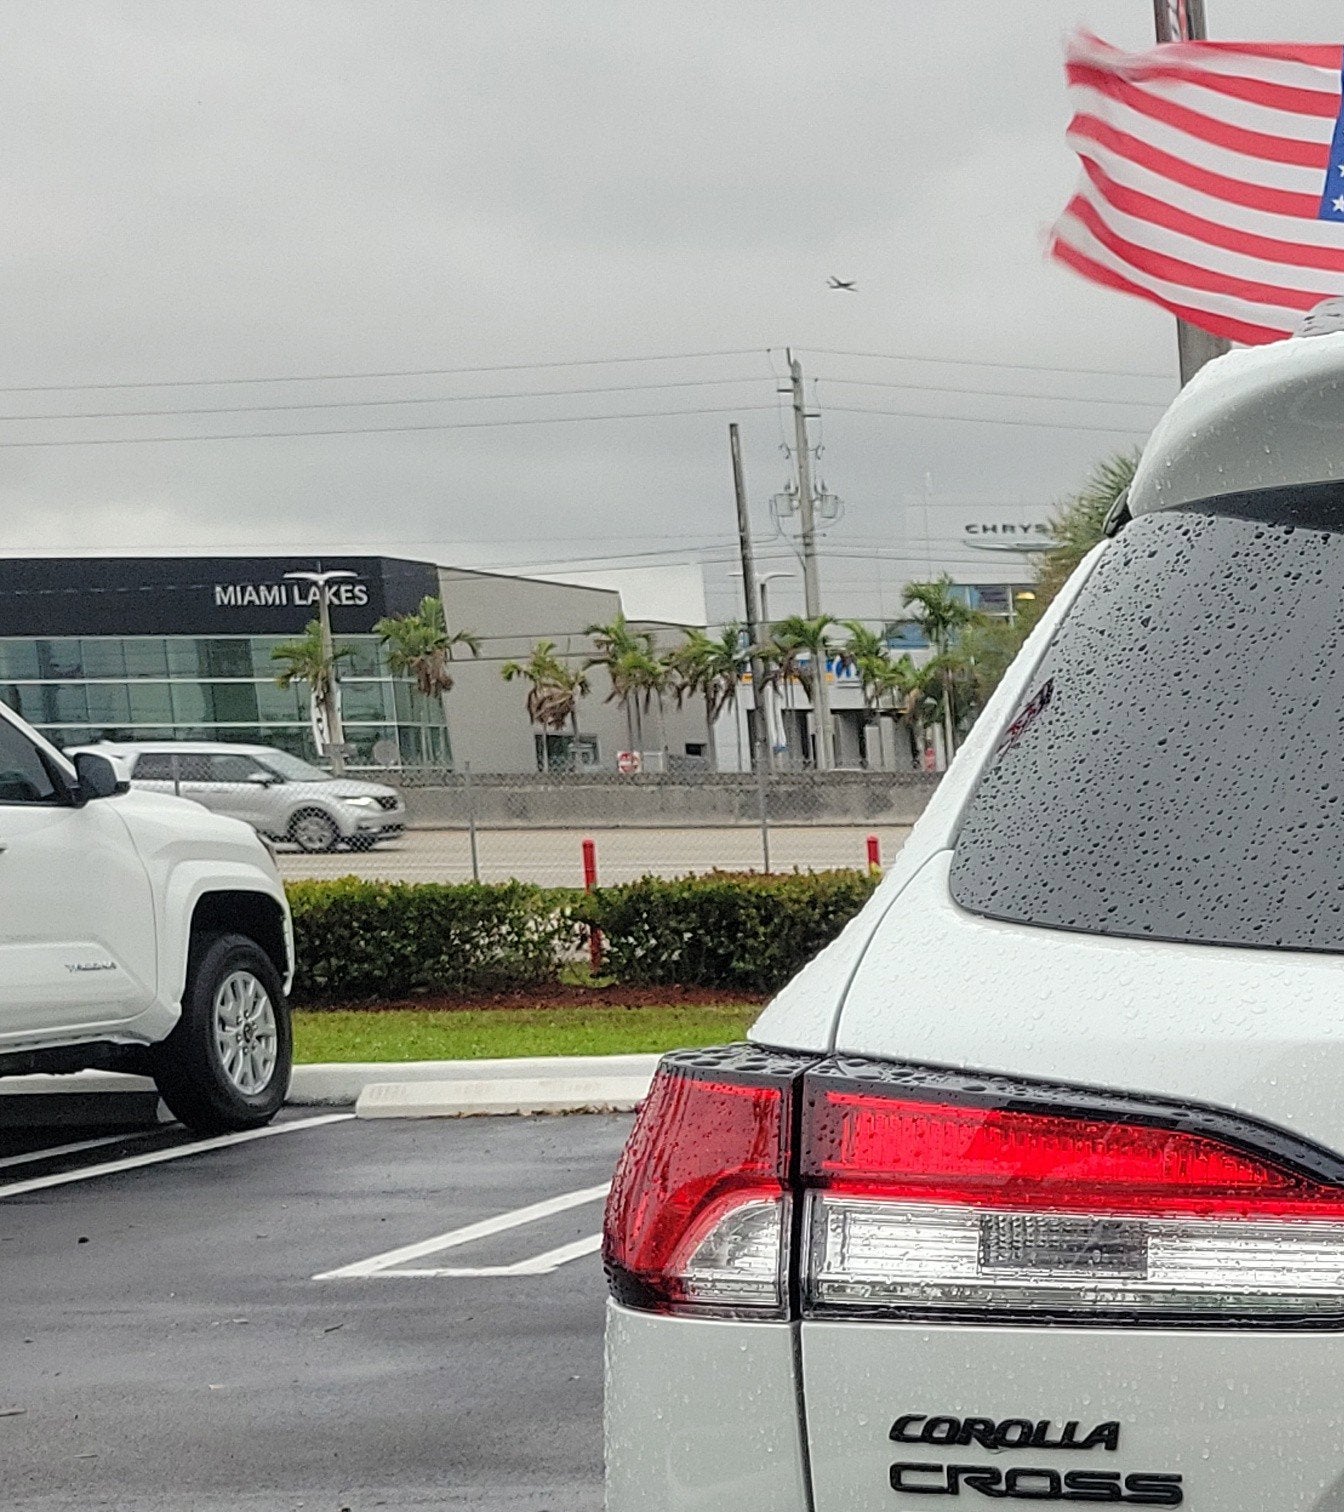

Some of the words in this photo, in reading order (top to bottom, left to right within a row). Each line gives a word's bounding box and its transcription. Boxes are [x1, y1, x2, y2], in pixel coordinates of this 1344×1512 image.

[215, 584, 287, 606] MIAMI
[293, 584, 369, 606] LAKES
[889, 1413, 1120, 1451] COROLLA
[889, 1461, 1184, 1506] CROSS
